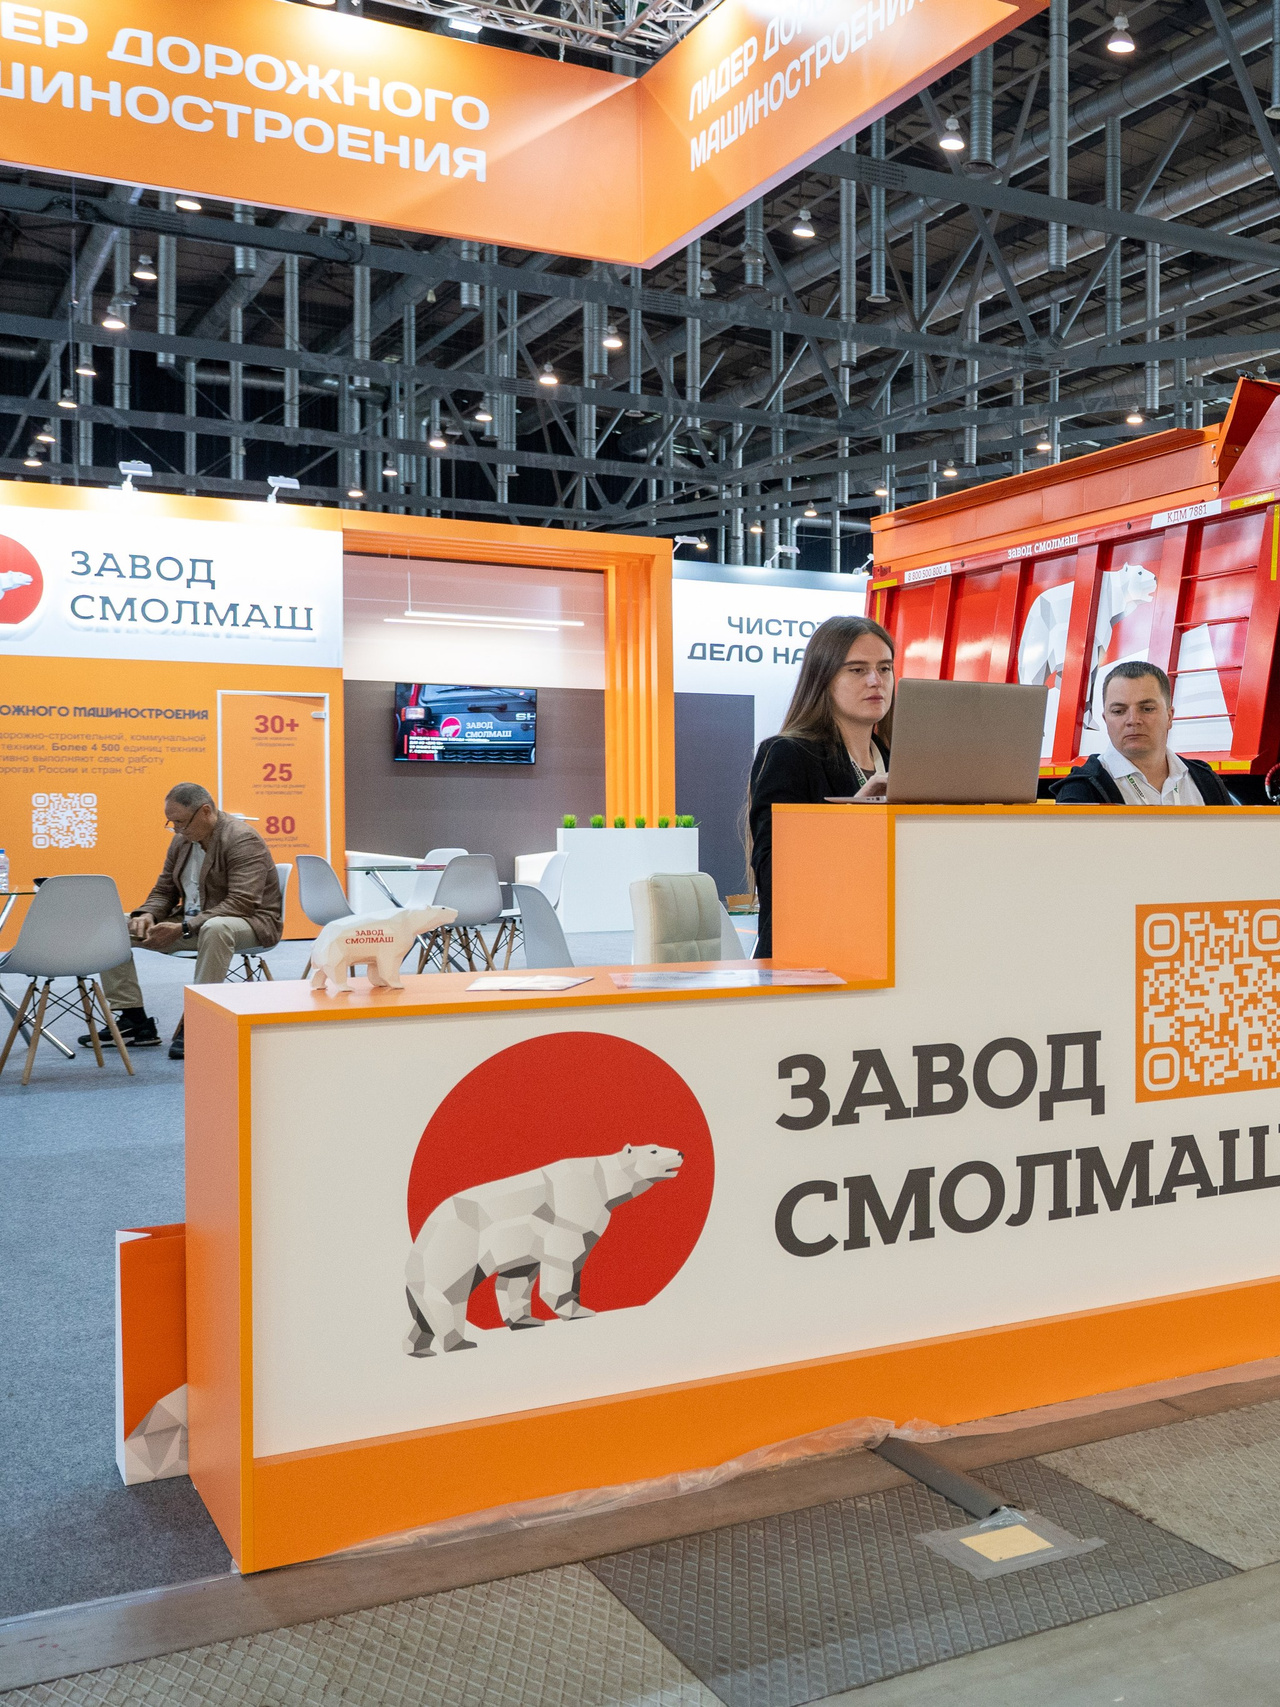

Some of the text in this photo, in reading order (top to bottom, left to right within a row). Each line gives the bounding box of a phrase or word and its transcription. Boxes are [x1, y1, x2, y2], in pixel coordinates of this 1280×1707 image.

[107, 27, 490, 130] ДОРОЖНОГО
[689, 36, 758, 121] ЛИДЕР
[690, 0, 925, 172] МАШИНОСТРОЕНИ
[1167, 504, 1208, 523] КДМ 7881
[70, 550, 216, 590] ЗАВОД
[907, 572, 912, 581] 8
[912, 570, 922, 580] 800
[922, 568, 932, 578] 500
[69, 594, 314, 631] СМОЛМАШ
[728, 616, 820, 638] ЧИСТО
[687, 642, 764, 663] ДЕЛО
[0, 704, 209, 720] ОЖНОГО МАШИНОСТРОЕНИЯ
[254, 715, 299, 733] 30+
[466, 722, 493, 730] ЗАВОД
[130, 733, 206, 744] коммунальной
[465, 730, 512, 738] СМОЛМАШ
[51, 743, 88, 751] Более
[101, 744, 120, 752] 500
[123, 745, 162, 754] единиц
[165, 745, 206, 753] техники
[32, 754, 94, 763] выполняют
[128, 755, 164, 765] работу
[38, 765, 78, 774] России
[91, 767, 122, 776] стран
[263, 763, 293, 781] 25
[265, 815, 295, 834] 80
[345, 936, 394, 944] СМОЛМАШ
[775, 1030, 1106, 1131] ЗАВОД
